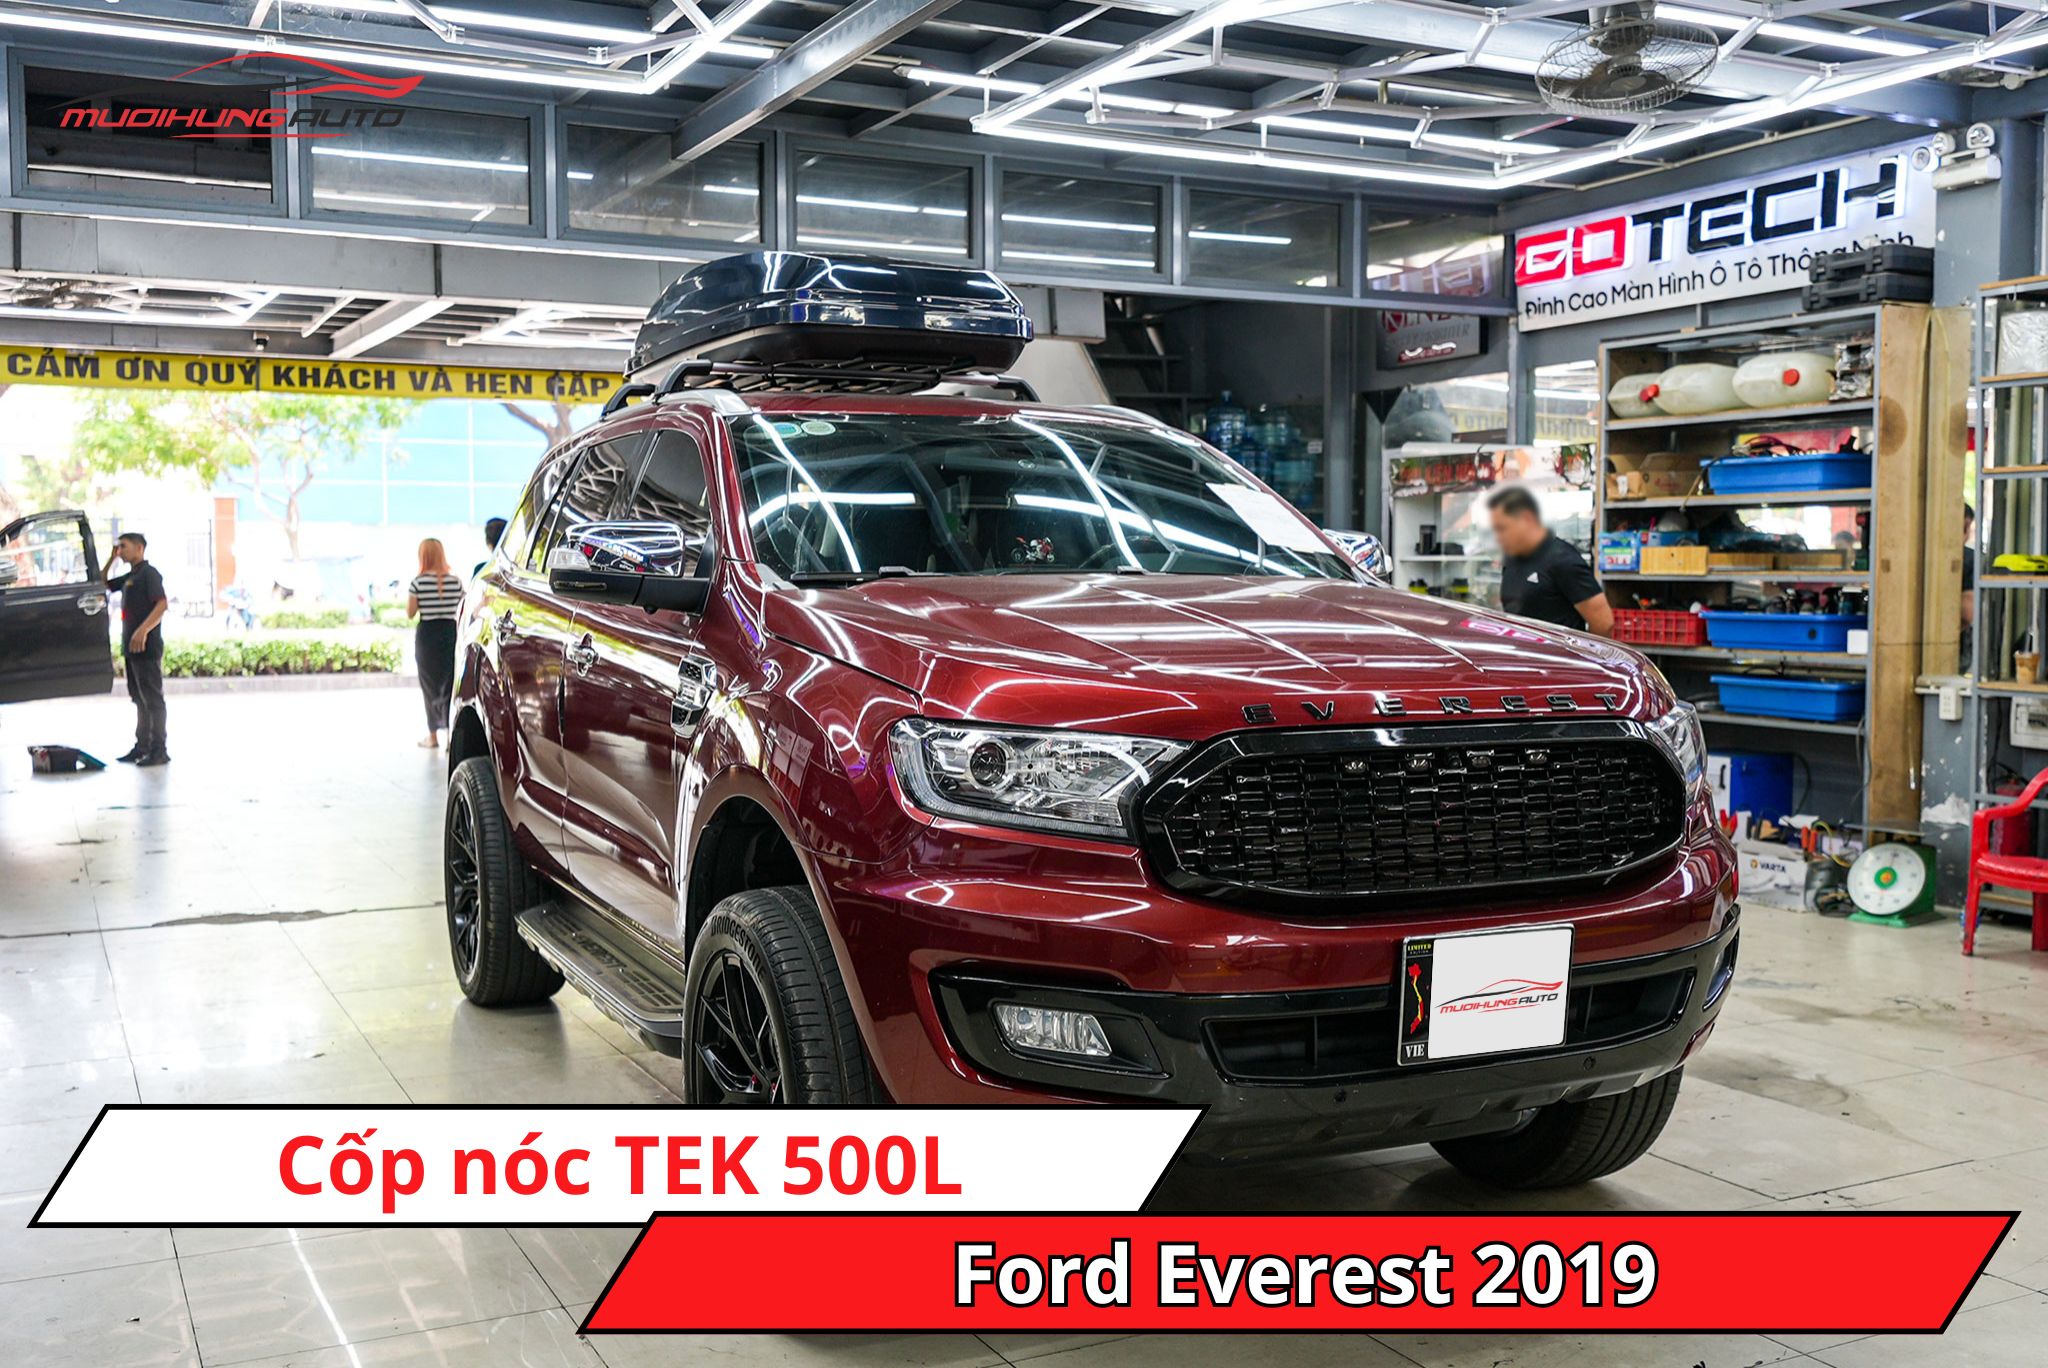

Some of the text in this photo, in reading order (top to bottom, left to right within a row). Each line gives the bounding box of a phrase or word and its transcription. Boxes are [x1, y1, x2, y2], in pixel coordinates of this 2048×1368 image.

[1515, 155, 1903, 287] GOTECH
[1569, 293, 1608, 311] Cao
[1612, 280, 1658, 304] Màn
[1659, 270, 1705, 296] Hình
[1709, 260, 1727, 286] Ô
[1734, 258, 1762, 283] Tô
[1768, 246, 1847, 276] Thô
[7, 347, 610, 401] CẢM ƠN QUÝ KHÁCH VÀ HẸN GẶP
[1241, 693, 1618, 723] EVEREST
[1760, 862, 1786, 874] VARTA
[711, 914, 768, 980] BRIDGESTONE
[1407, 943, 1432, 951] LIMITED
[1405, 1044, 1425, 1058] VIE
